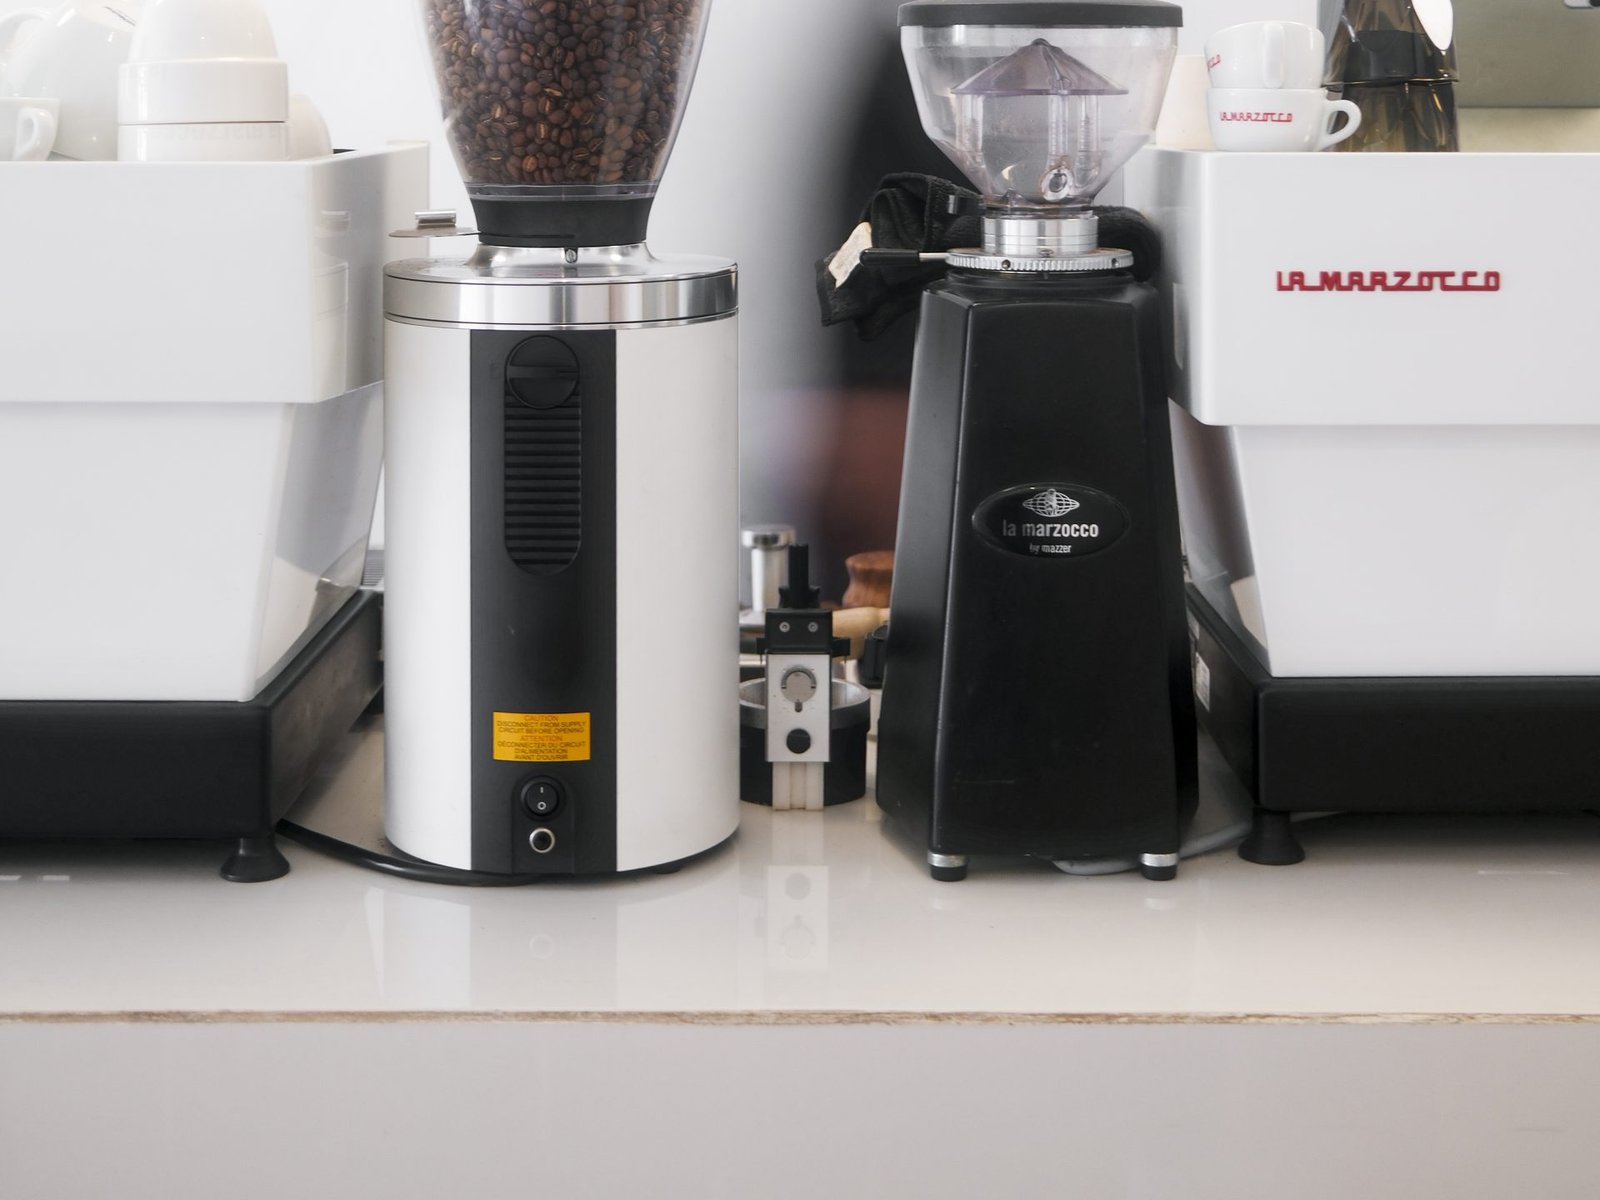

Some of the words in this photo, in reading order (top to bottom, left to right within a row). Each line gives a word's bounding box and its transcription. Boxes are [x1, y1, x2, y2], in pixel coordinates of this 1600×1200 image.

[1276, 271, 1305, 291] LA
[1320, 271, 1500, 291] MARZOCCO
[1002, 519, 1017, 537] la
[1022, 523, 1100, 538] marzocco
[1029, 543, 1040, 555] by
[1041, 544, 1072, 553] mazzer
